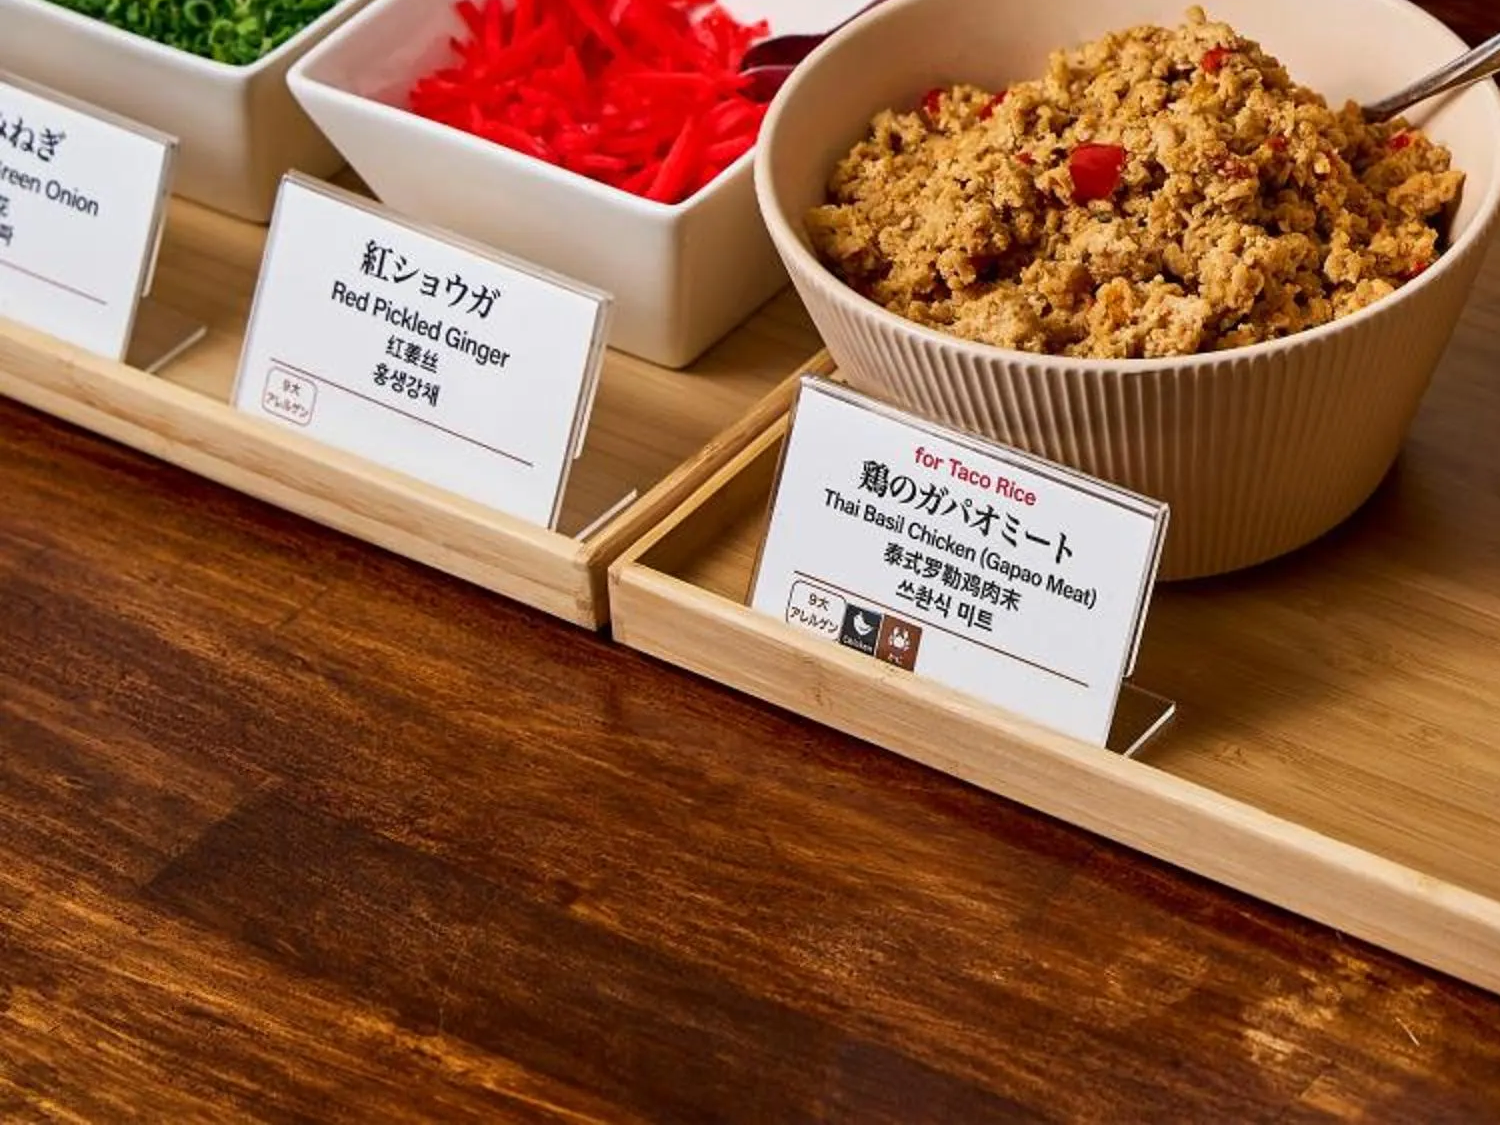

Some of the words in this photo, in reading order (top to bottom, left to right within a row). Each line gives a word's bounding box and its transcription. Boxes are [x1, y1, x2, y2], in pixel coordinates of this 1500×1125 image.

[0, 163, 40, 194] reen
[46, 179, 99, 217] Onion
[359, 239, 502, 320] 紅ショウガ
[331, 280, 368, 312] Red
[372, 296, 441, 342] Pickled
[445, 326, 511, 369] Ginger
[372, 362, 441, 408] 홍생강채
[914, 446, 944, 472] for
[949, 458, 991, 490] Taco
[996, 475, 1037, 507] Rice
[857, 459, 1074, 565] 鶏のガパオミート
[824, 488, 861, 518] Thai
[863, 502, 905, 534] Basil
[907, 521, 976, 565] Chicken
[979, 545, 1042, 588] (Gapao
[1046, 573, 1098, 611] Meat)
[883, 542, 1023, 612] 泰式罗勒鸡肉末
[790, 606, 839, 634] アレルゲン
[808, 592, 829, 612] 9大
[895, 579, 951, 619] 쓰촨식
[957, 602, 994, 632] 미트
